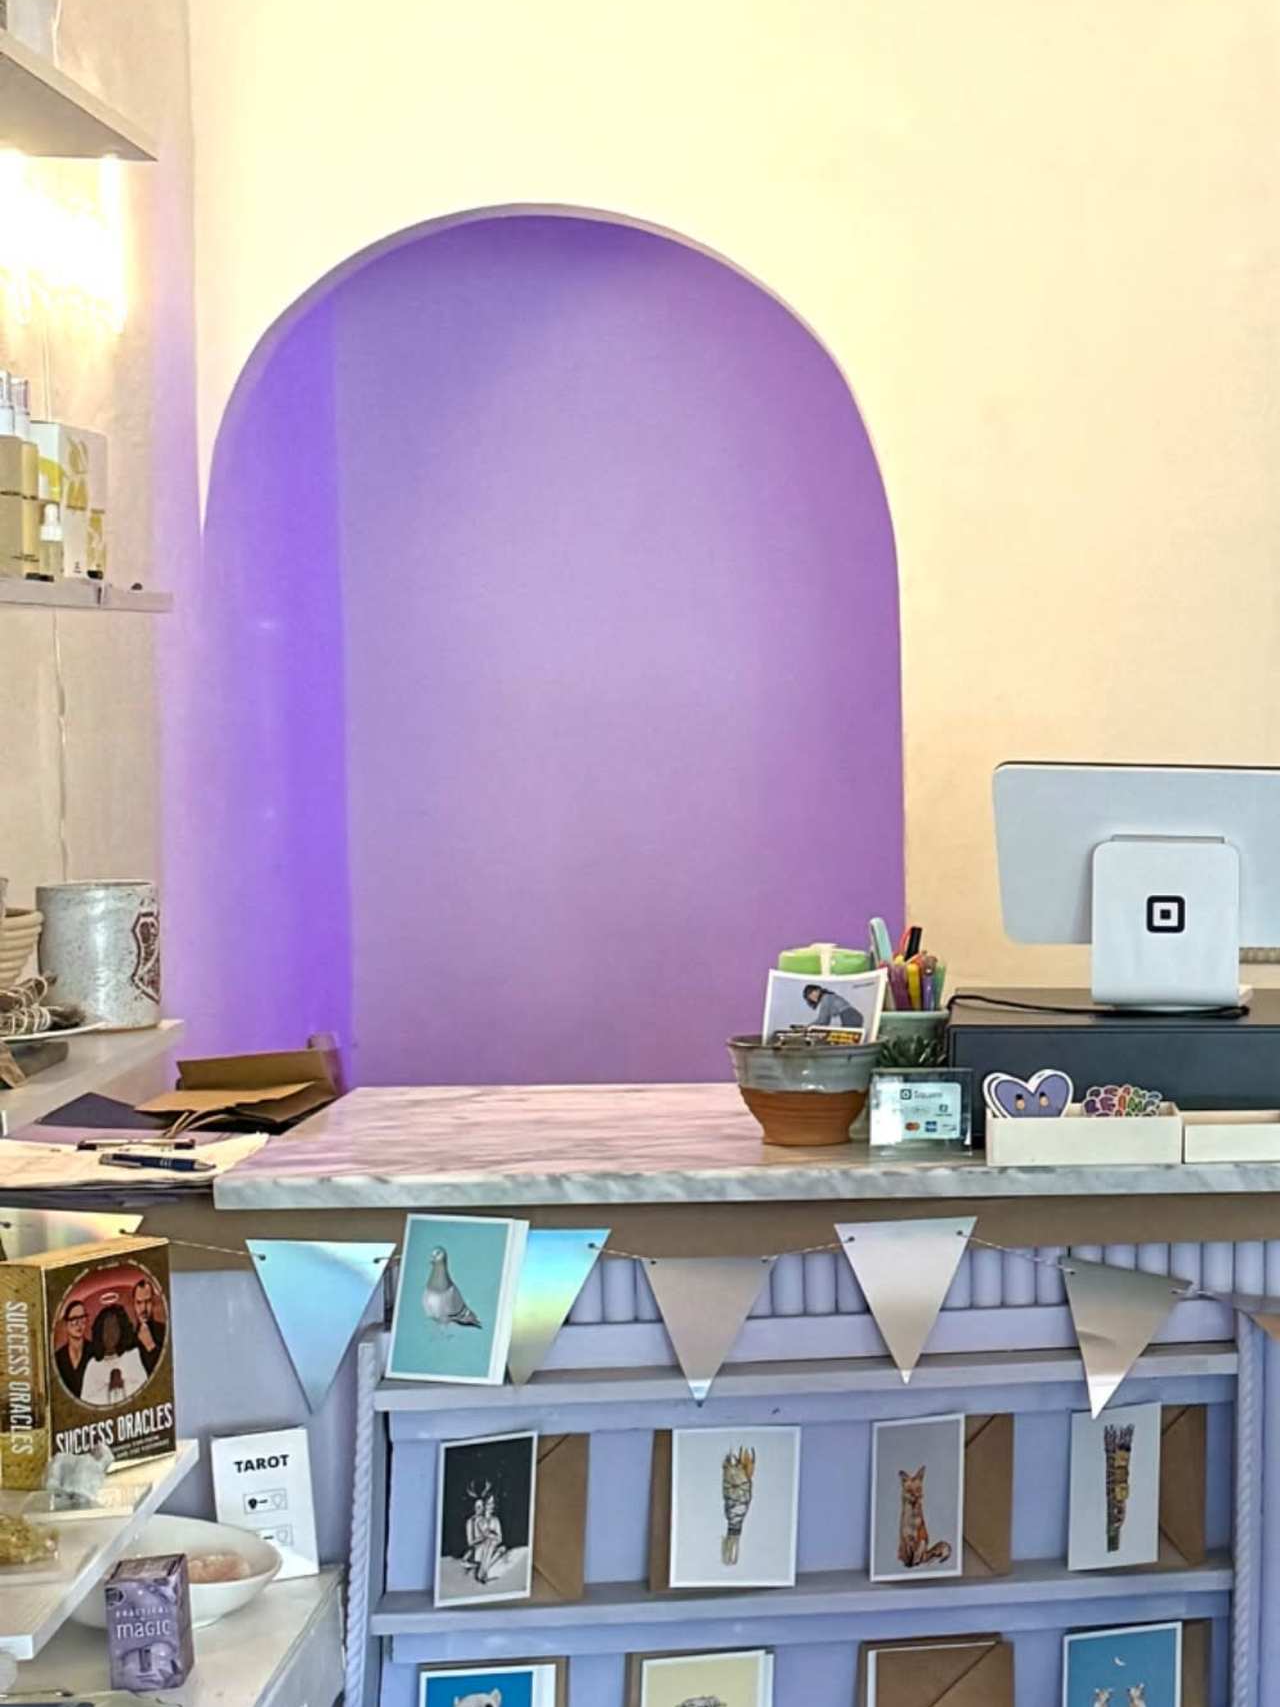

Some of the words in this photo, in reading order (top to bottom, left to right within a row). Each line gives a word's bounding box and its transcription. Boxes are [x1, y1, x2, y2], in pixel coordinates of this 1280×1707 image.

[4, 1301, 31, 1376] SUCCESS
[8, 1381, 33, 1455] ORACLES
[56, 1419, 114, 1455] SUCCESS
[117, 1402, 173, 1442] ORACLES
[233, 1453, 290, 1474] TAROT
